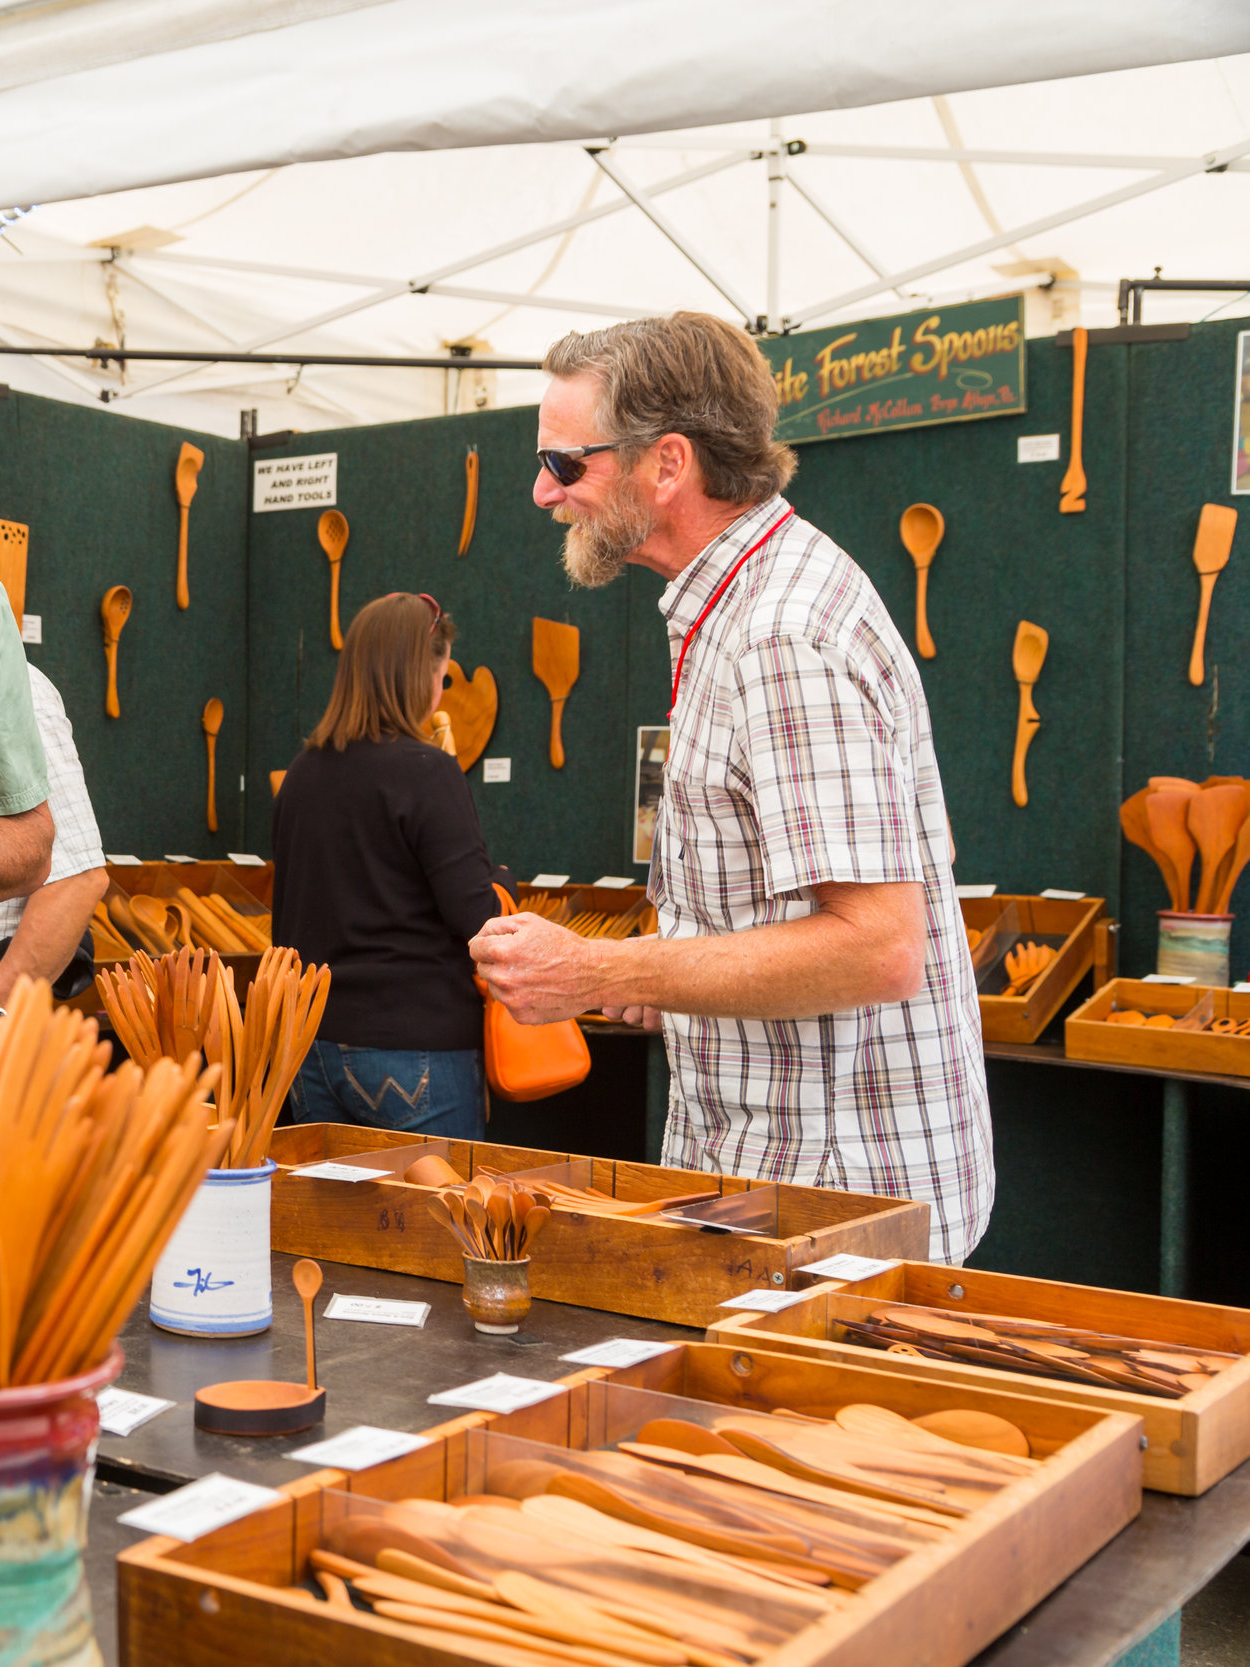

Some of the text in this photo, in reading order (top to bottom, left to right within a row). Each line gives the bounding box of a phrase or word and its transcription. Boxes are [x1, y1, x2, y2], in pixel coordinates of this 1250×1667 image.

[813, 325, 907, 399] Forest
[908, 315, 1020, 382] Spoons
[816, 404, 862, 435] Richard
[257, 459, 333, 475] WE HAVE LEFT
[271, 475, 329, 489] AND RIGHT
[263, 490, 333, 505] HAND TOOLS
